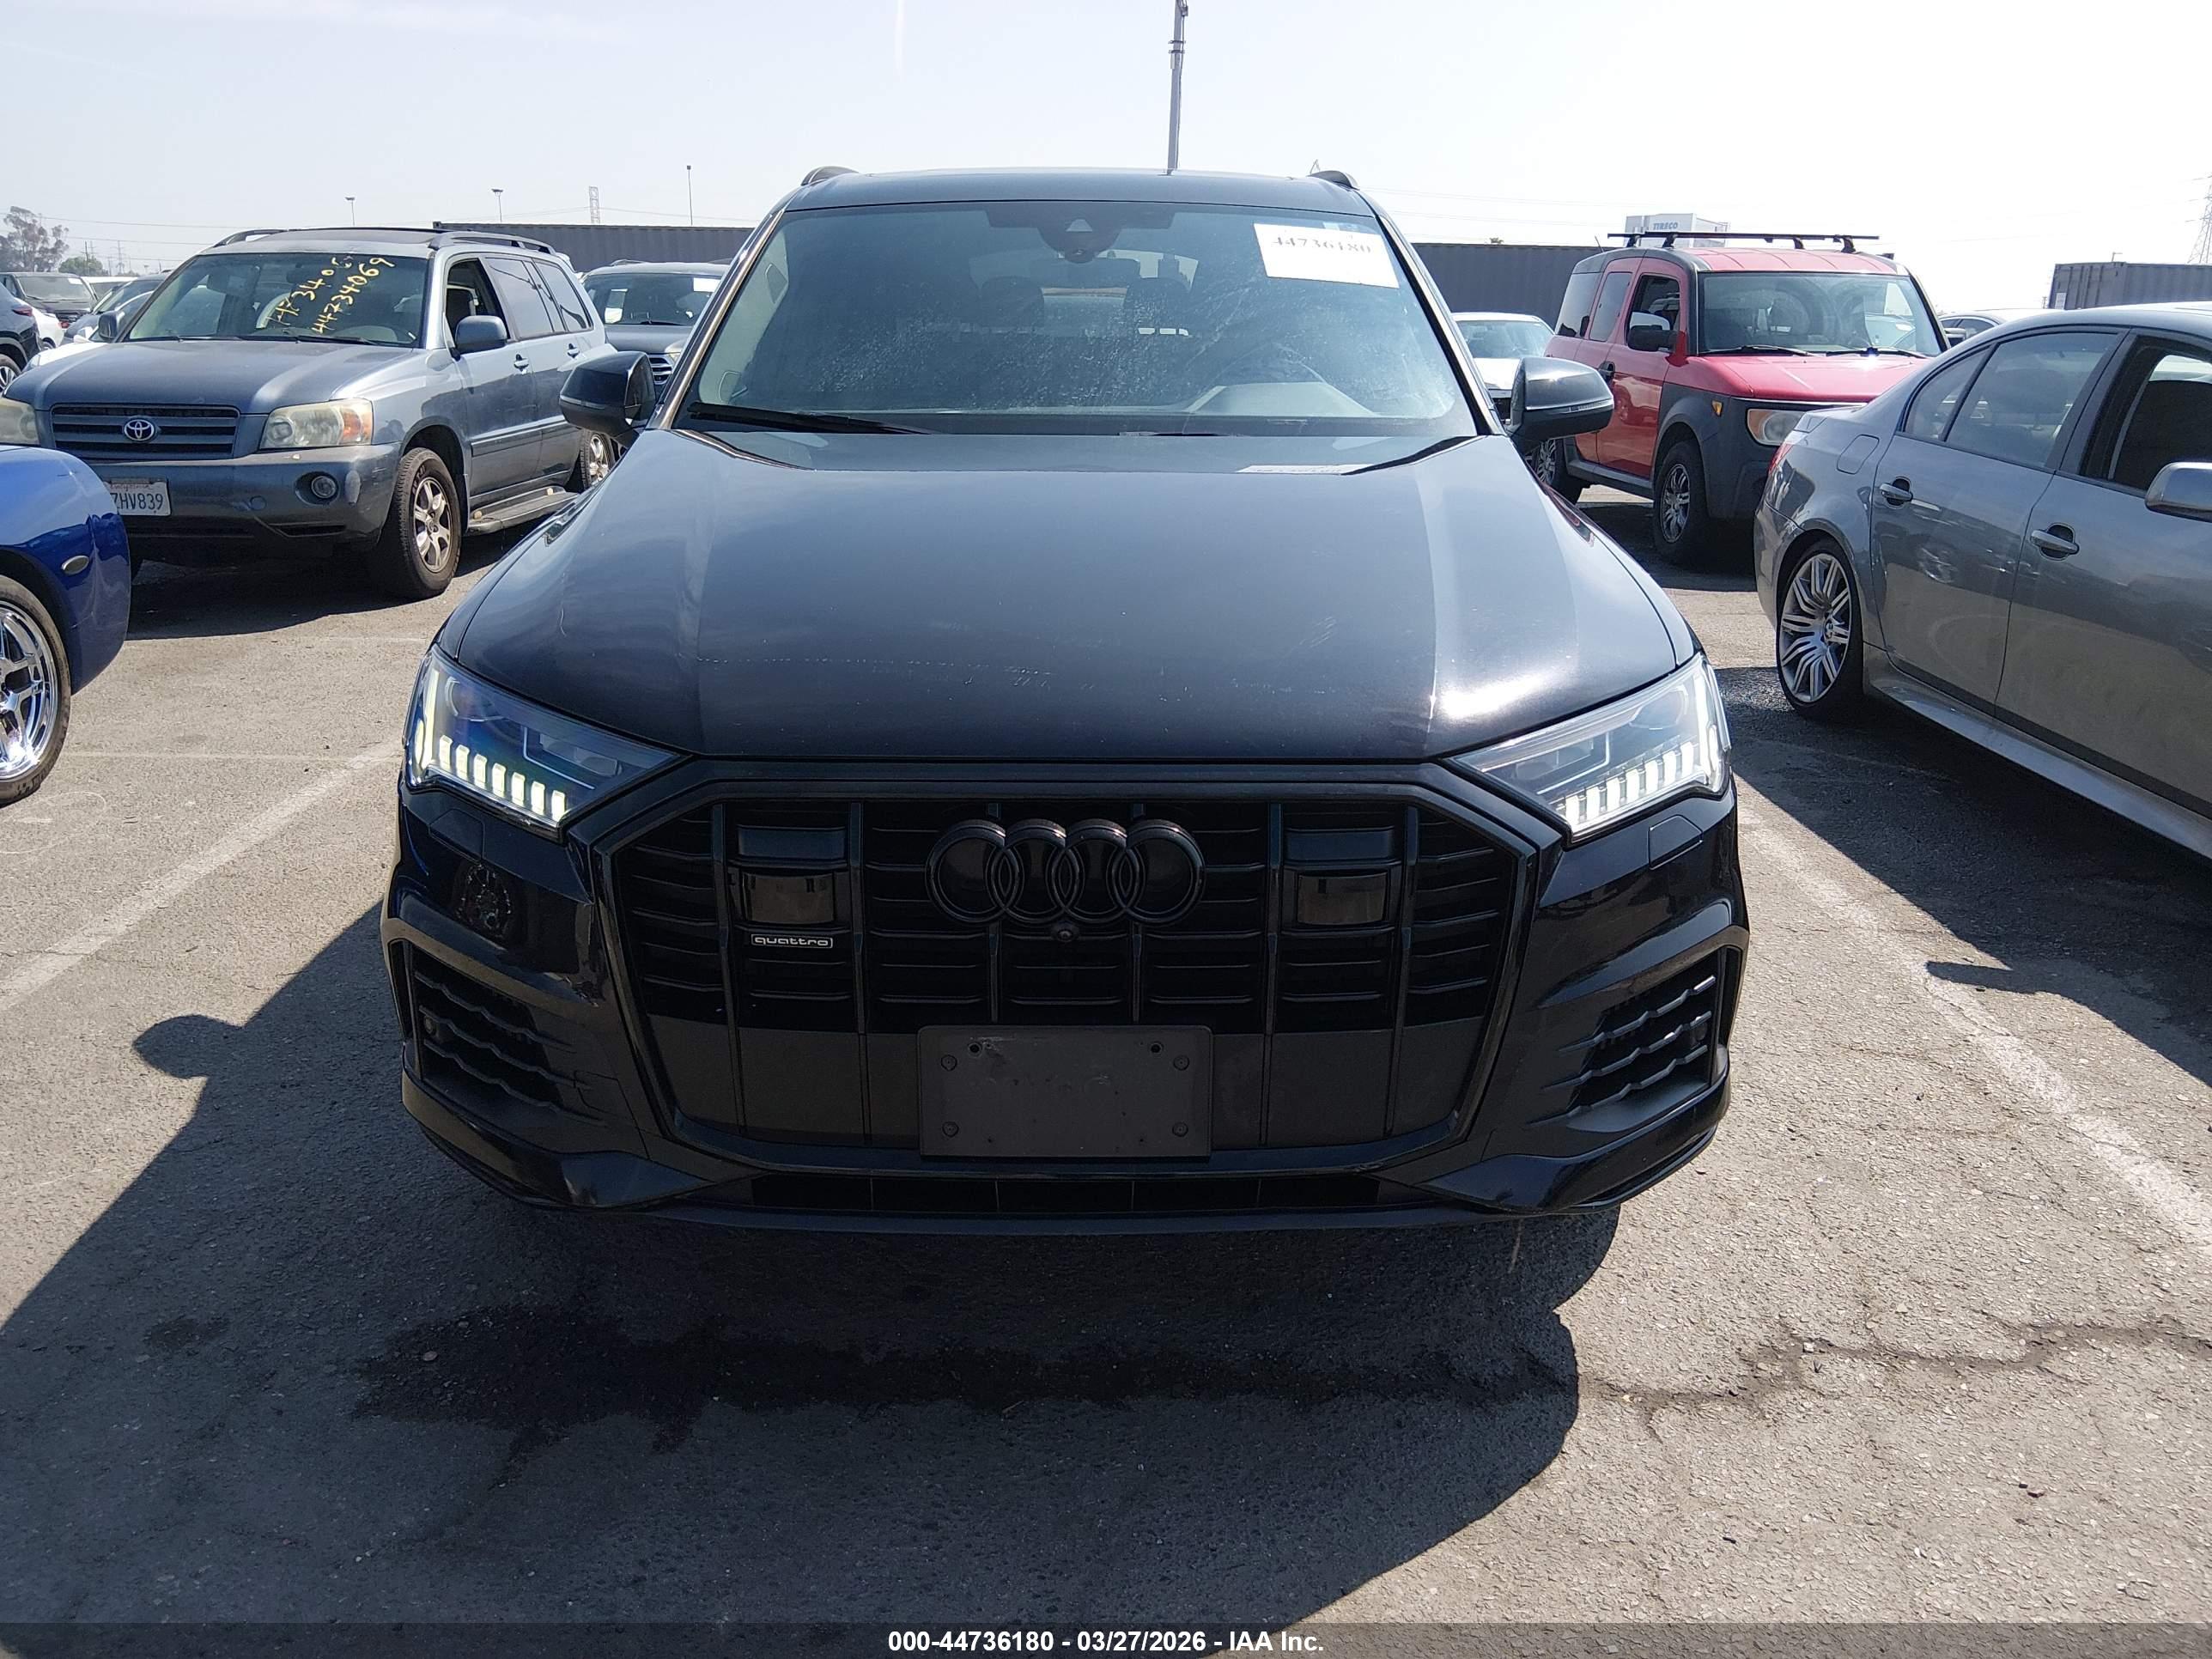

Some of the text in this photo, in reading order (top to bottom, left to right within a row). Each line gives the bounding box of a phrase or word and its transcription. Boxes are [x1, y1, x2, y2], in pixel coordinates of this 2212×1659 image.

[1653, 222, 1678, 230] TIRECO
[311, 257, 396, 333] 44734069
[754, 936, 829, 946] quattro
